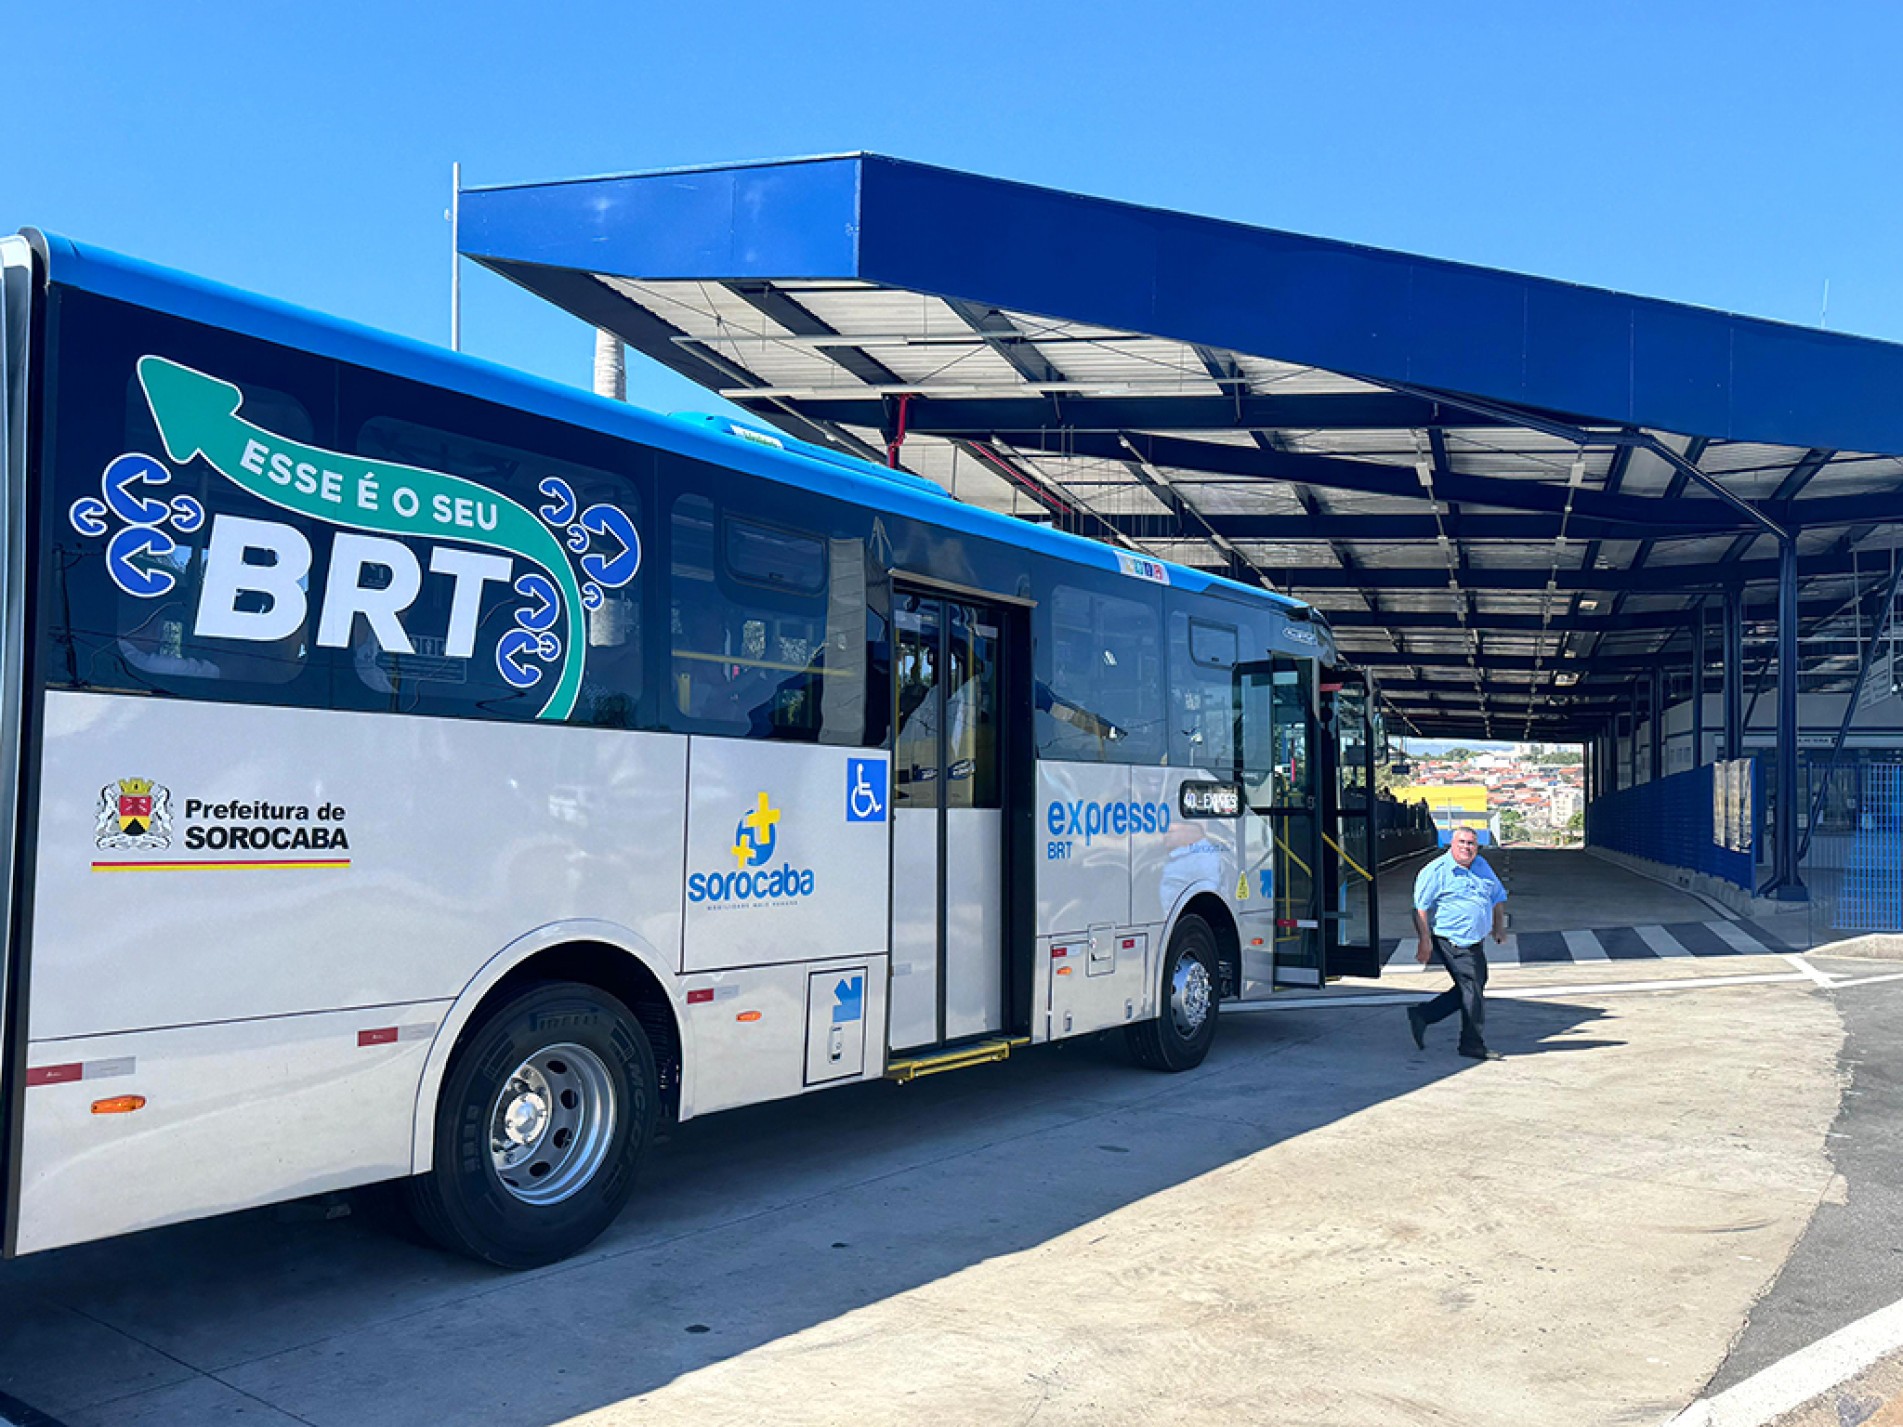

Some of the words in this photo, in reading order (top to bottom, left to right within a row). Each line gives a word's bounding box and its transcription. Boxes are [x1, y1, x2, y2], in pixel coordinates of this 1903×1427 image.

[240, 438, 343, 503] ESSE
[357, 472, 379, 510] É
[392, 487, 420, 517] O
[432, 494, 497, 530] SEU
[194, 513, 513, 658] BRT
[185, 799, 309, 820] Prefeitura
[317, 802, 346, 821] de
[1047, 799, 1170, 846] expresso
[185, 826, 349, 849] SOROCABA
[1047, 841, 1072, 859] BRT
[688, 862, 815, 901] sorocaba
